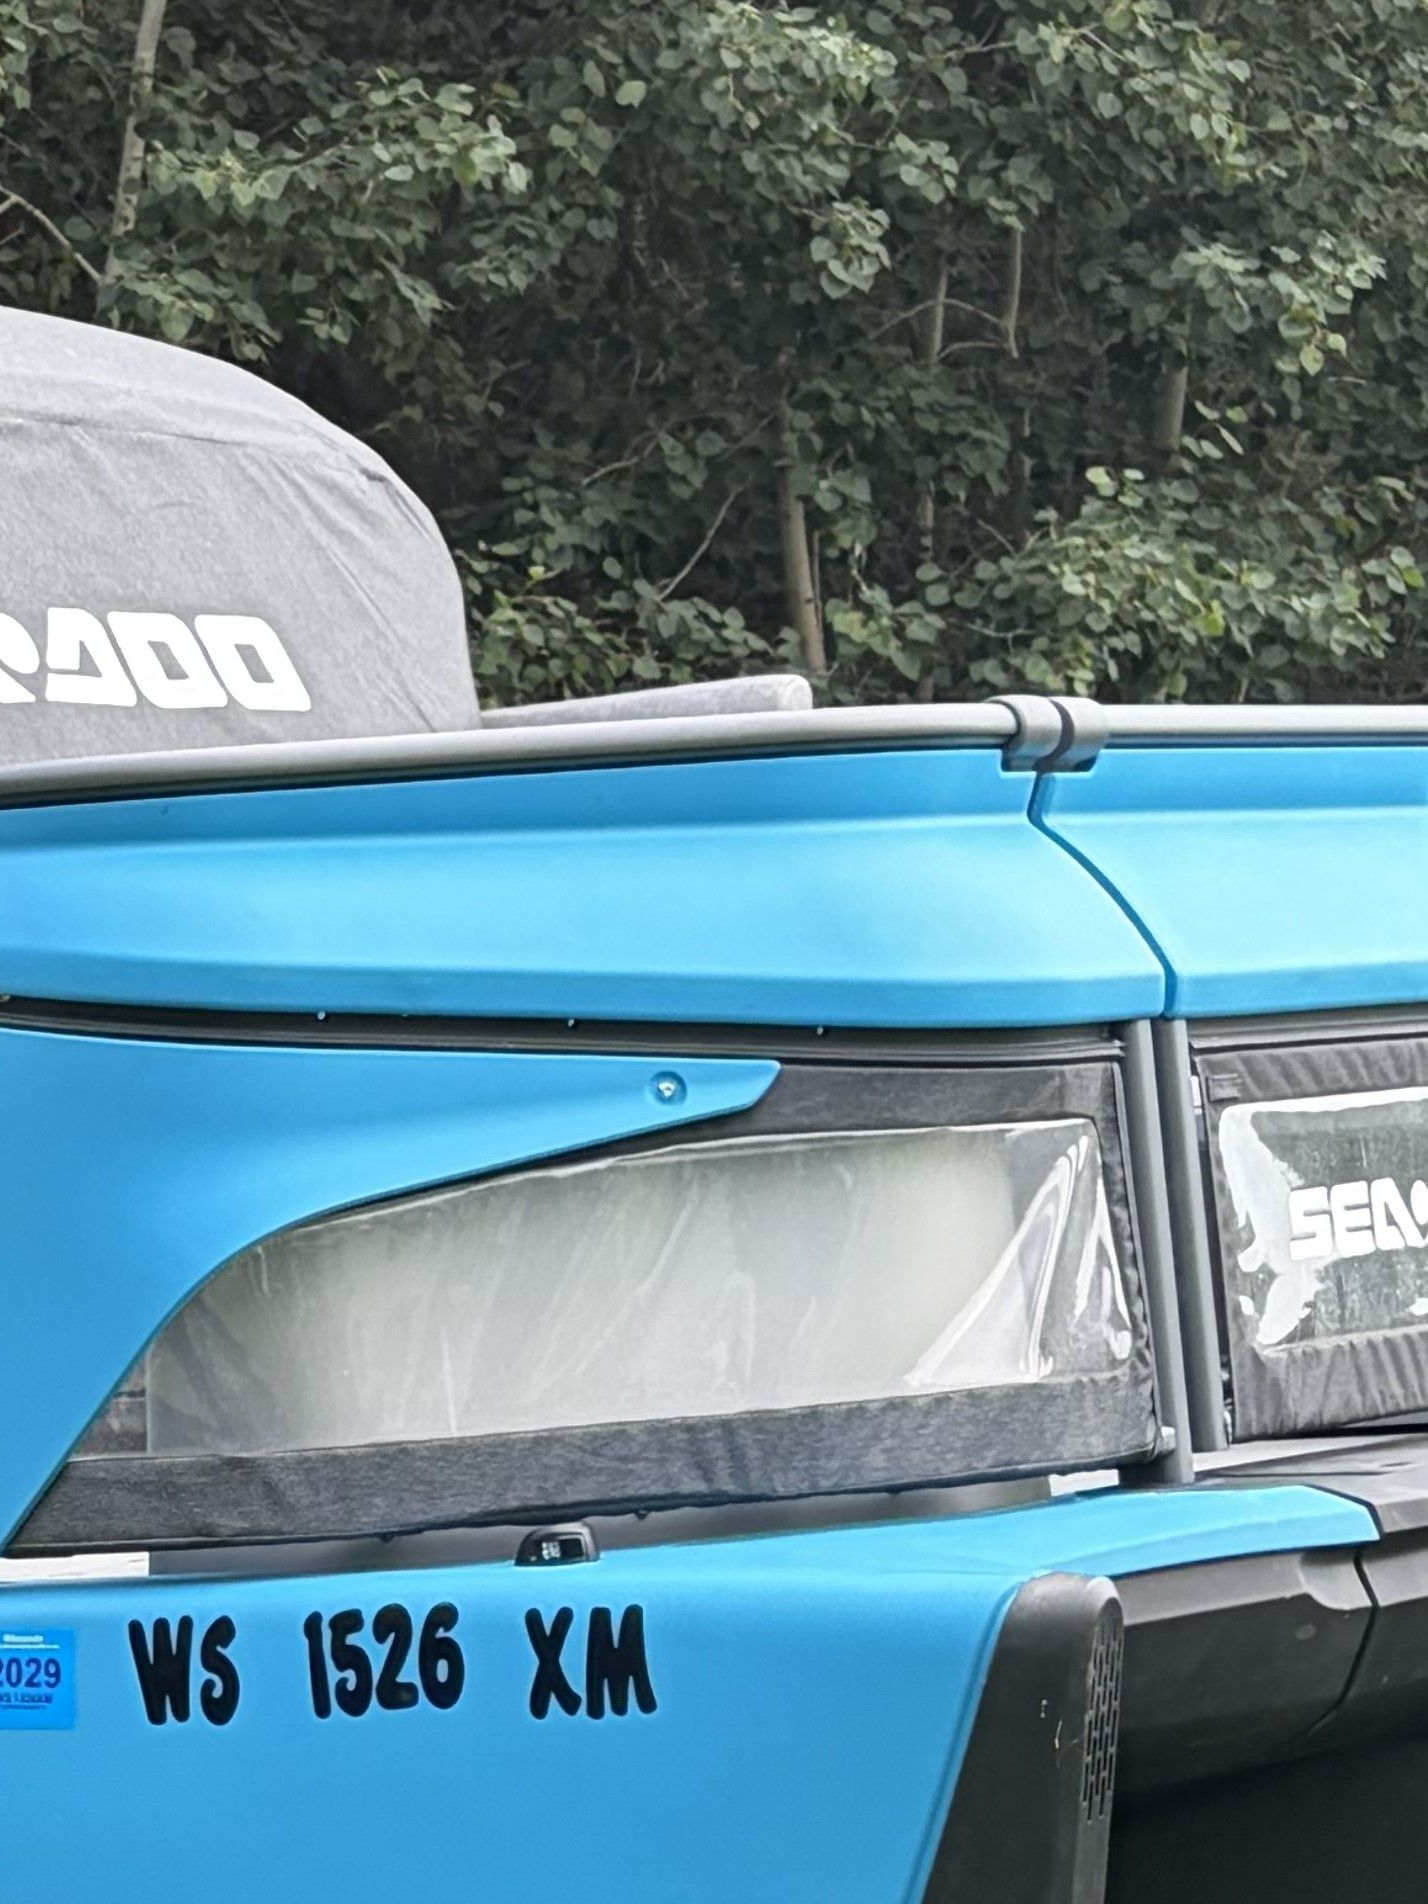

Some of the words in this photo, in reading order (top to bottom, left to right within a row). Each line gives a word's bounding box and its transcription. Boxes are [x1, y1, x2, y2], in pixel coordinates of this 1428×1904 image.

[128, 1614, 241, 1726] WS
[303, 1601, 466, 1719] 1526
[524, 1603, 659, 1720] XM
